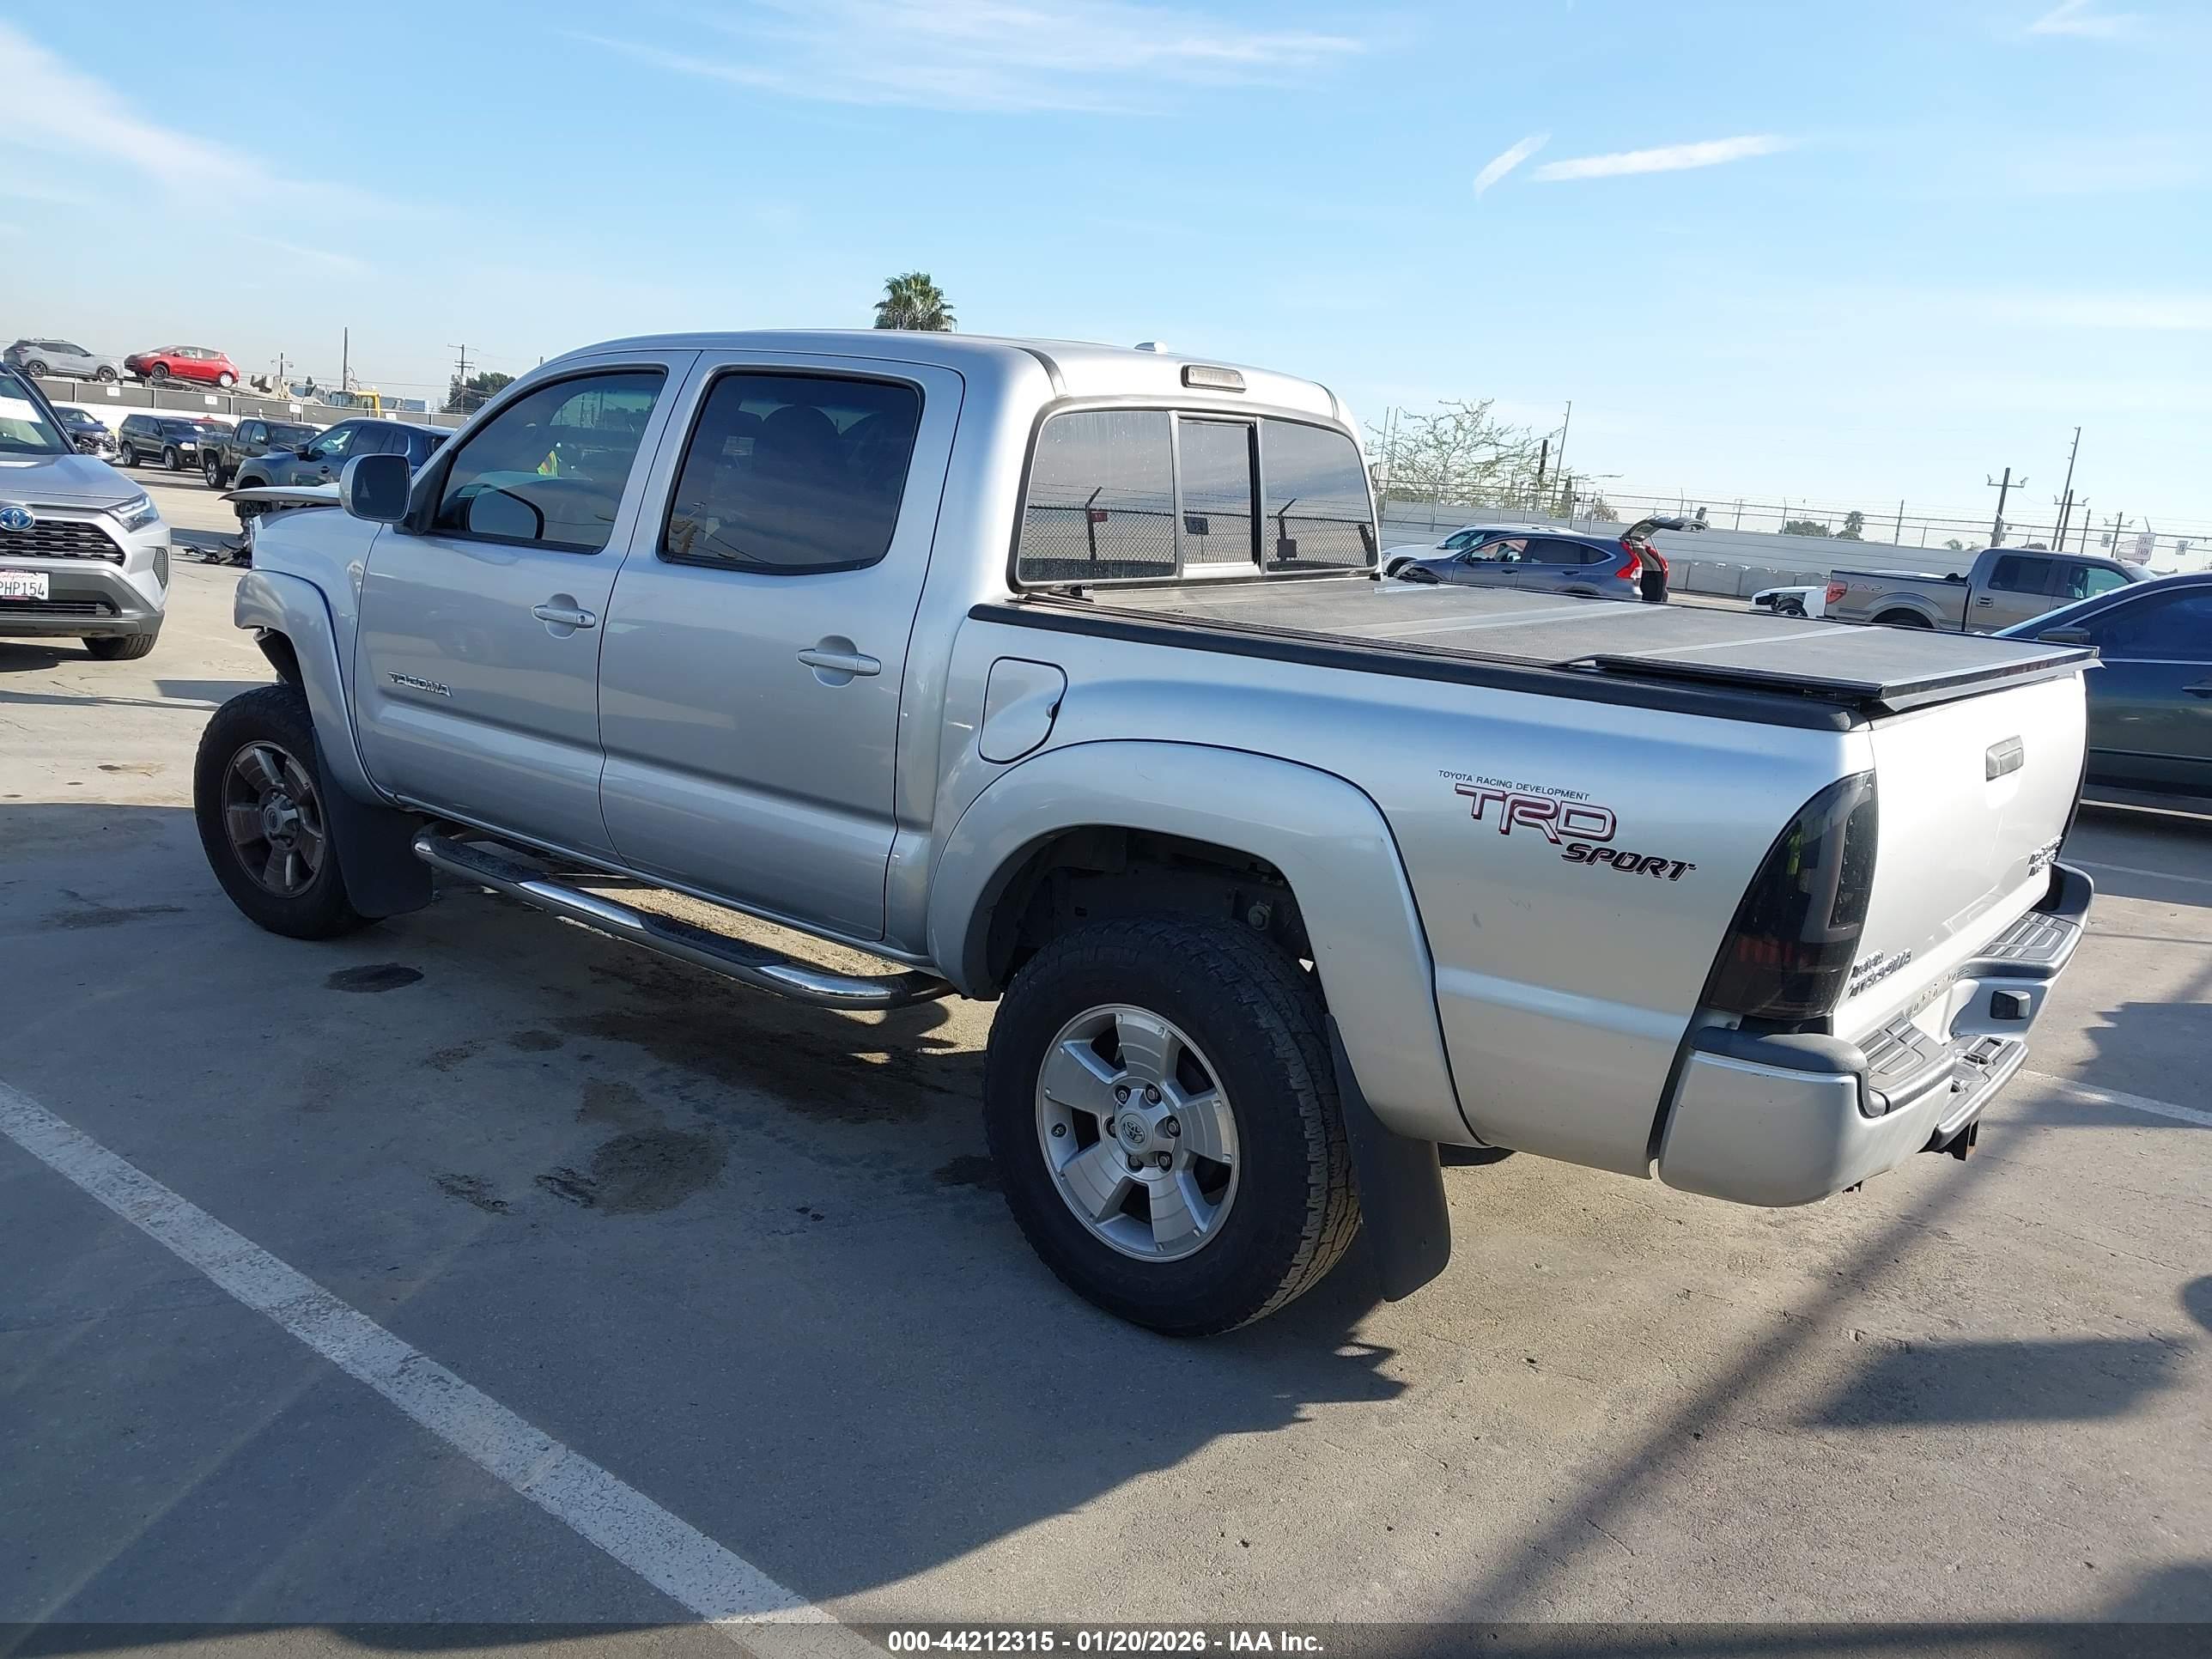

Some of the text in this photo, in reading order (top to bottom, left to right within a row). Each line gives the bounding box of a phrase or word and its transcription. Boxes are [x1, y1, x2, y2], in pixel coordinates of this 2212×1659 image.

[2138, 537, 2154, 545] STATE
[387, 671, 453, 698] TACOMA
[1437, 769, 1590, 801] TOYOTA RACING DEVELOPMENT
[1455, 782, 1617, 846] TRD
[1561, 842, 1697, 881] SPORT
